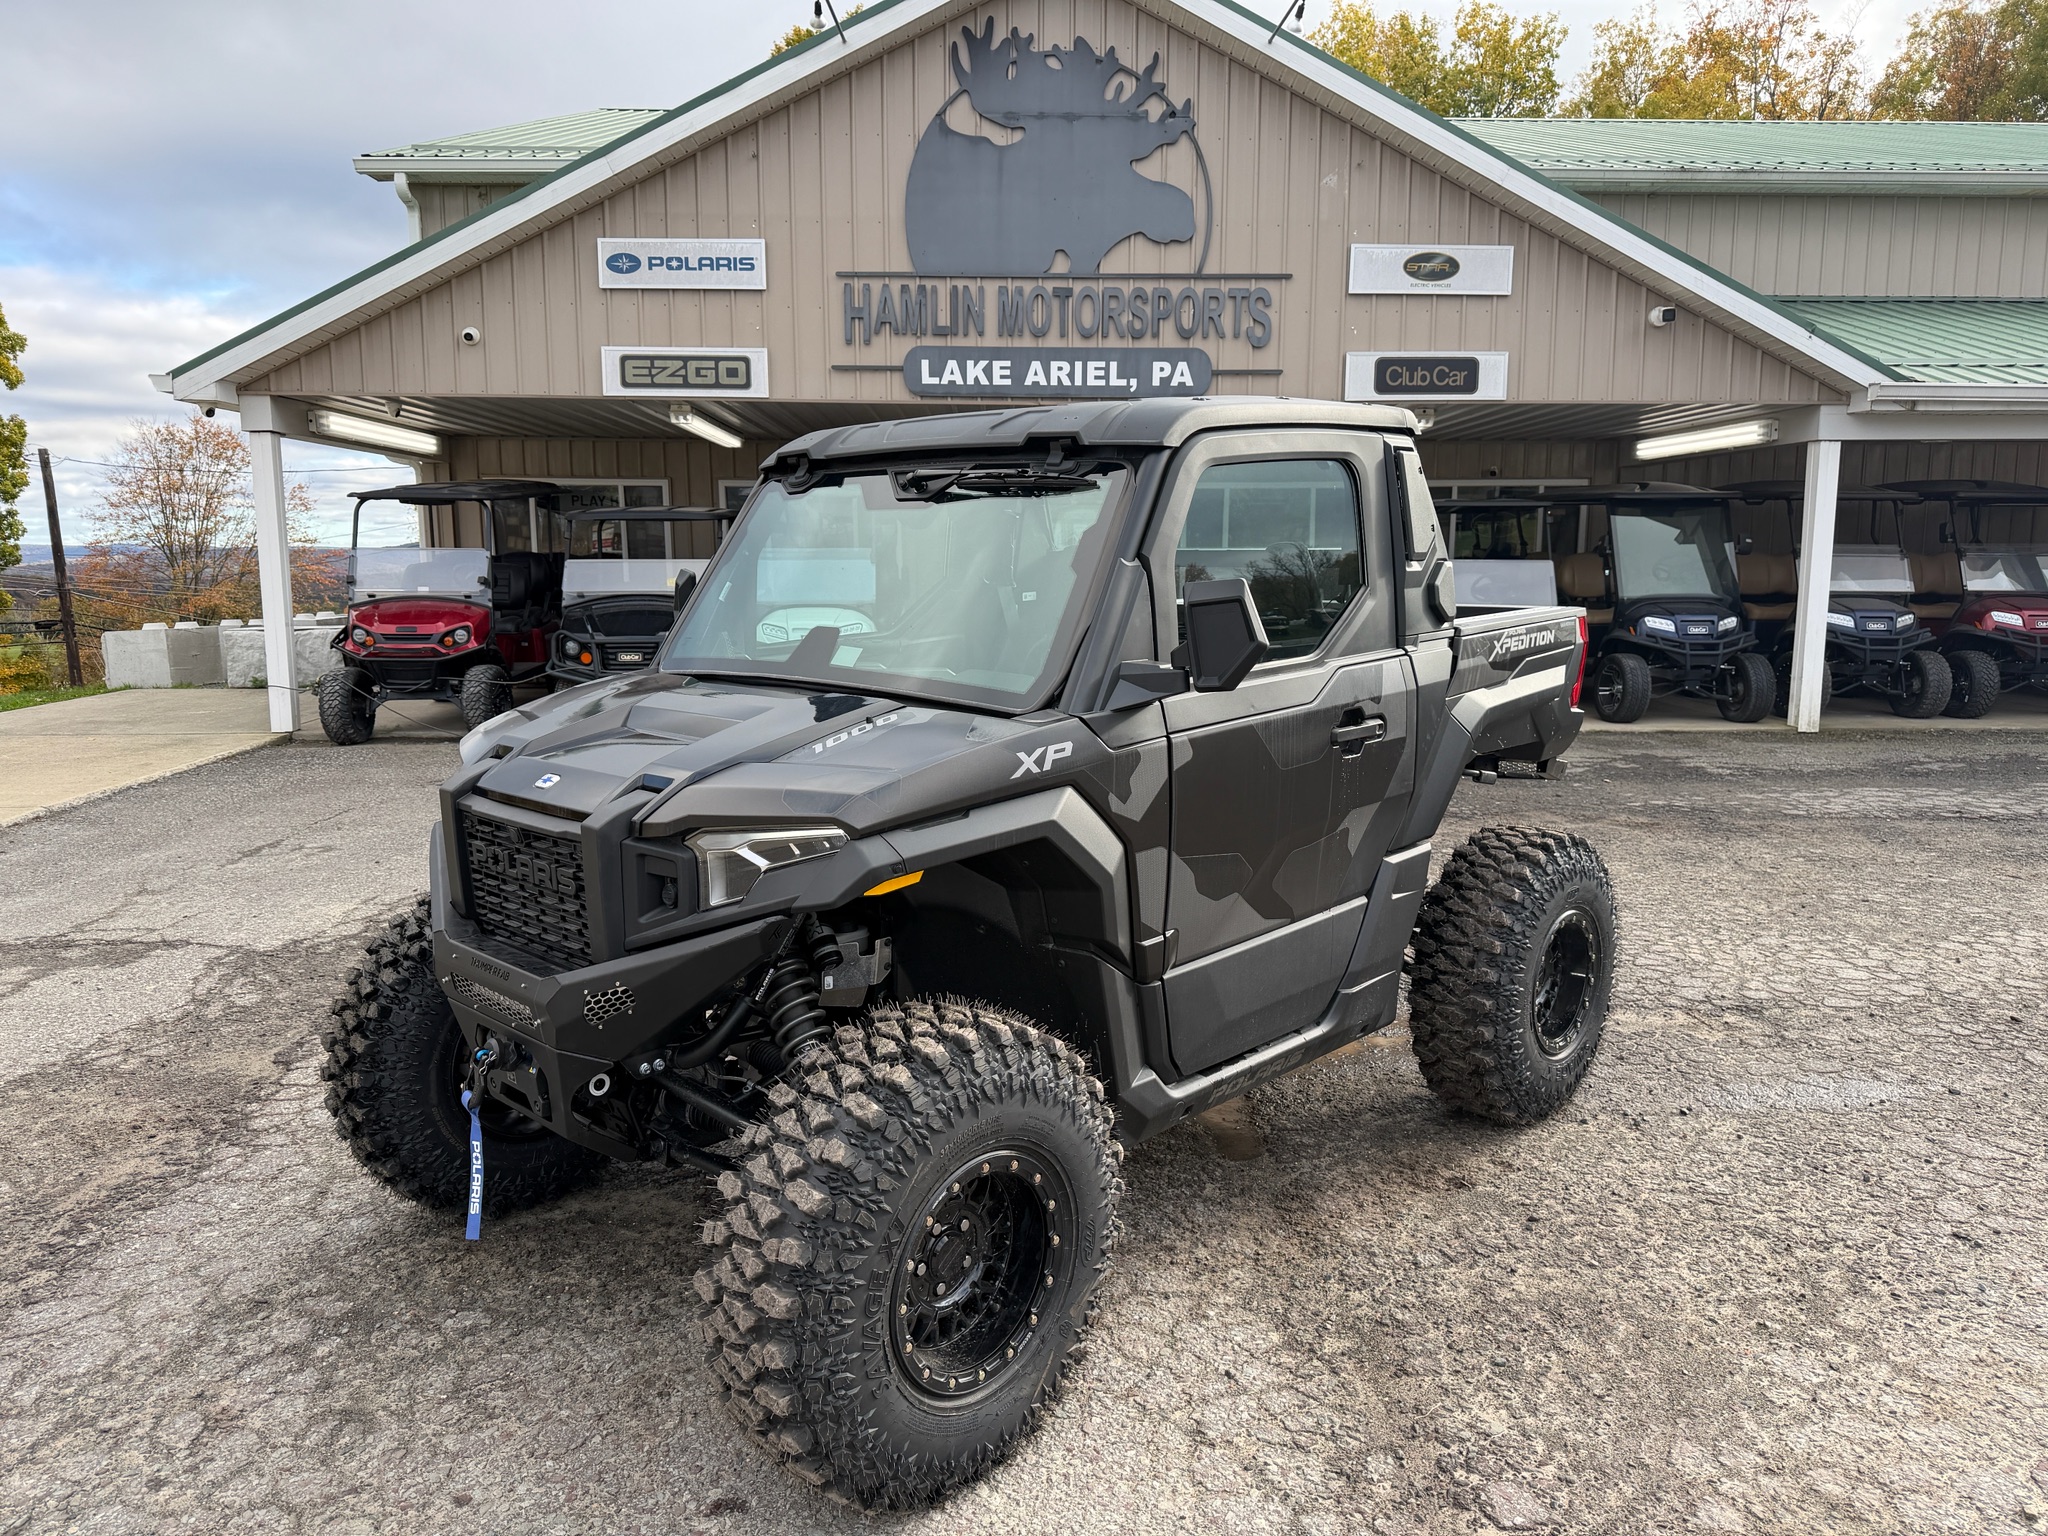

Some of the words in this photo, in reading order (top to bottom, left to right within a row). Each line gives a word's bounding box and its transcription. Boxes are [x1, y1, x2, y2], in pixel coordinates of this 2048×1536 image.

[647, 256, 756, 272] POLARIS
[1406, 262, 1450, 272] STAR
[843, 282, 985, 345] HAMLIN
[998, 285, 1272, 349] MOTORSPORTS
[624, 359, 747, 384] EZGO
[921, 359, 1012, 386] LAKE
[1024, 360, 1138, 393] ARIEL,
[1152, 361, 1194, 387] PA
[1386, 365, 1430, 386] Club
[1433, 365, 1468, 386] Car
[571, 495, 606, 507] PLAY
[1488, 629, 1555, 662] XPEDITION
[812, 714, 898, 754] 1000
[1010, 741, 1074, 779] XP
[471, 842, 577, 896] POLARIS
[1208, 1047, 1306, 1104] POLARIS
[469, 1140, 482, 1215] POLARIS
[862, 1268, 892, 1400] SAVAGE
